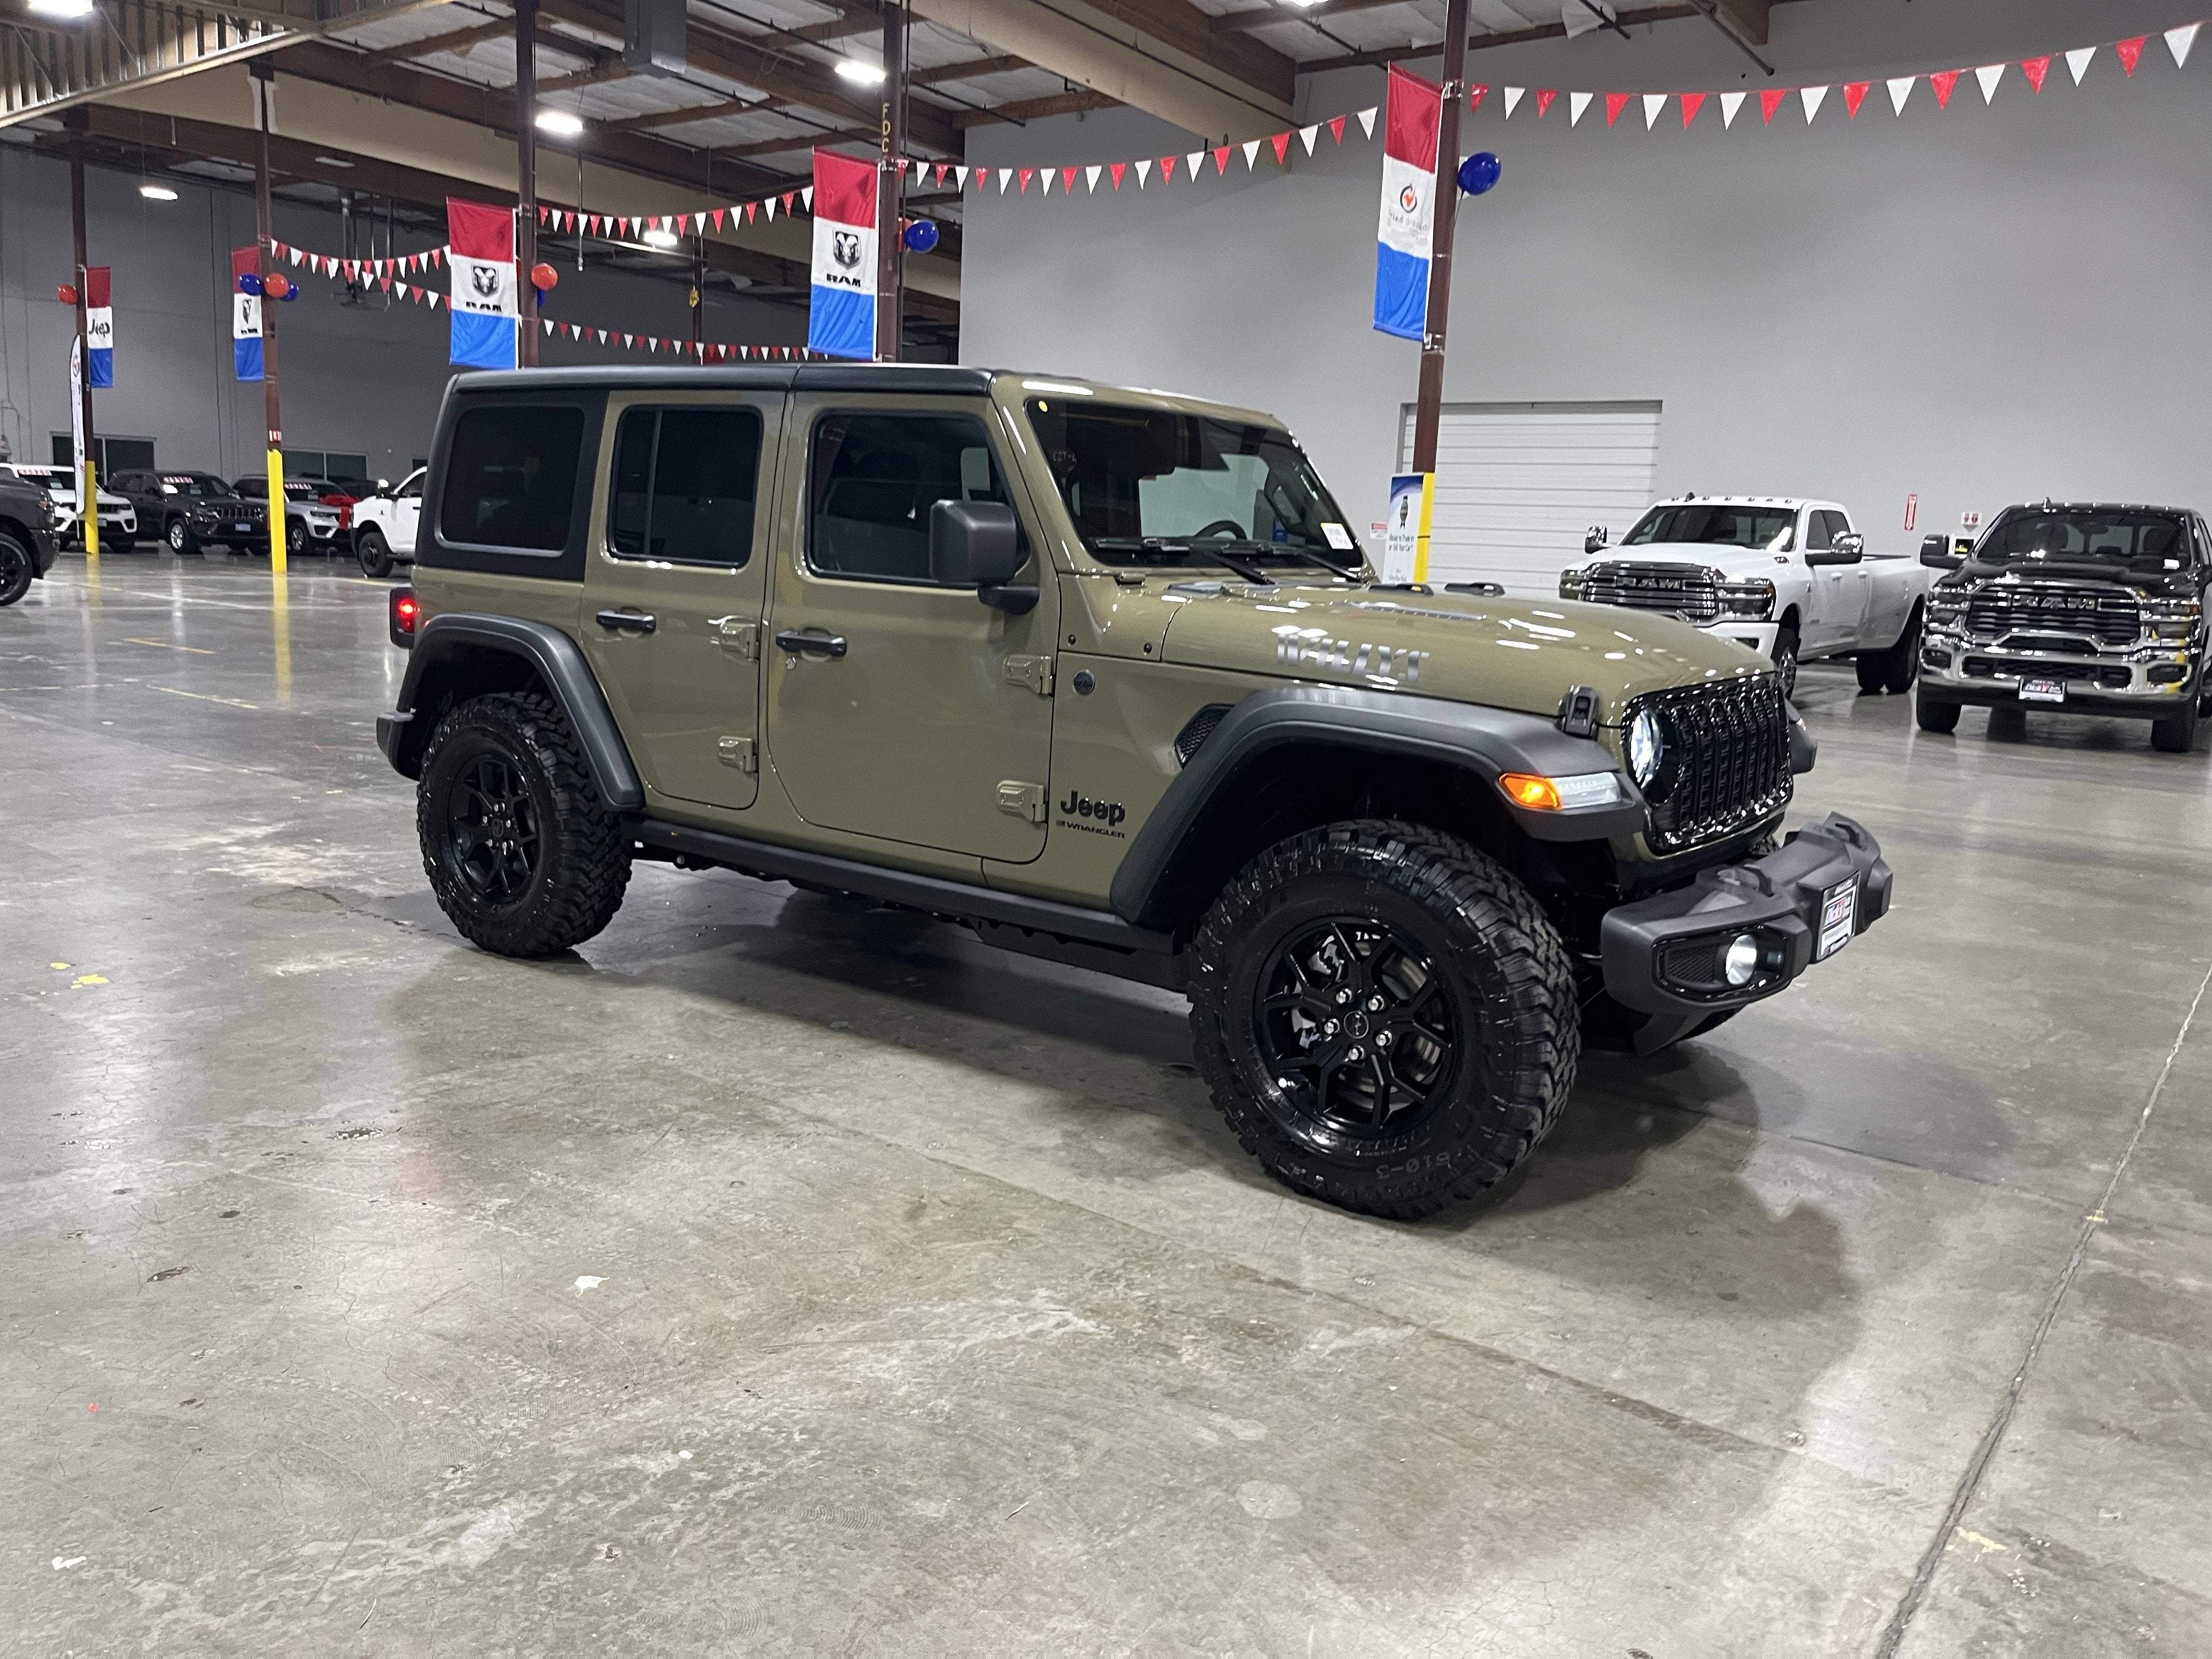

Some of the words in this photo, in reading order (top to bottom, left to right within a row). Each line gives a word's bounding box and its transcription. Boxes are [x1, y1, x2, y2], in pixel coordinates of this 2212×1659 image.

[882, 103, 891, 153] FDC
[827, 273, 861, 287] RAM
[1616, 577, 1680, 588] RAM
[2012, 594, 2095, 610] RAM
[1060, 790, 1125, 827] Jeep
[1066, 822, 1125, 839] WRANGLER
